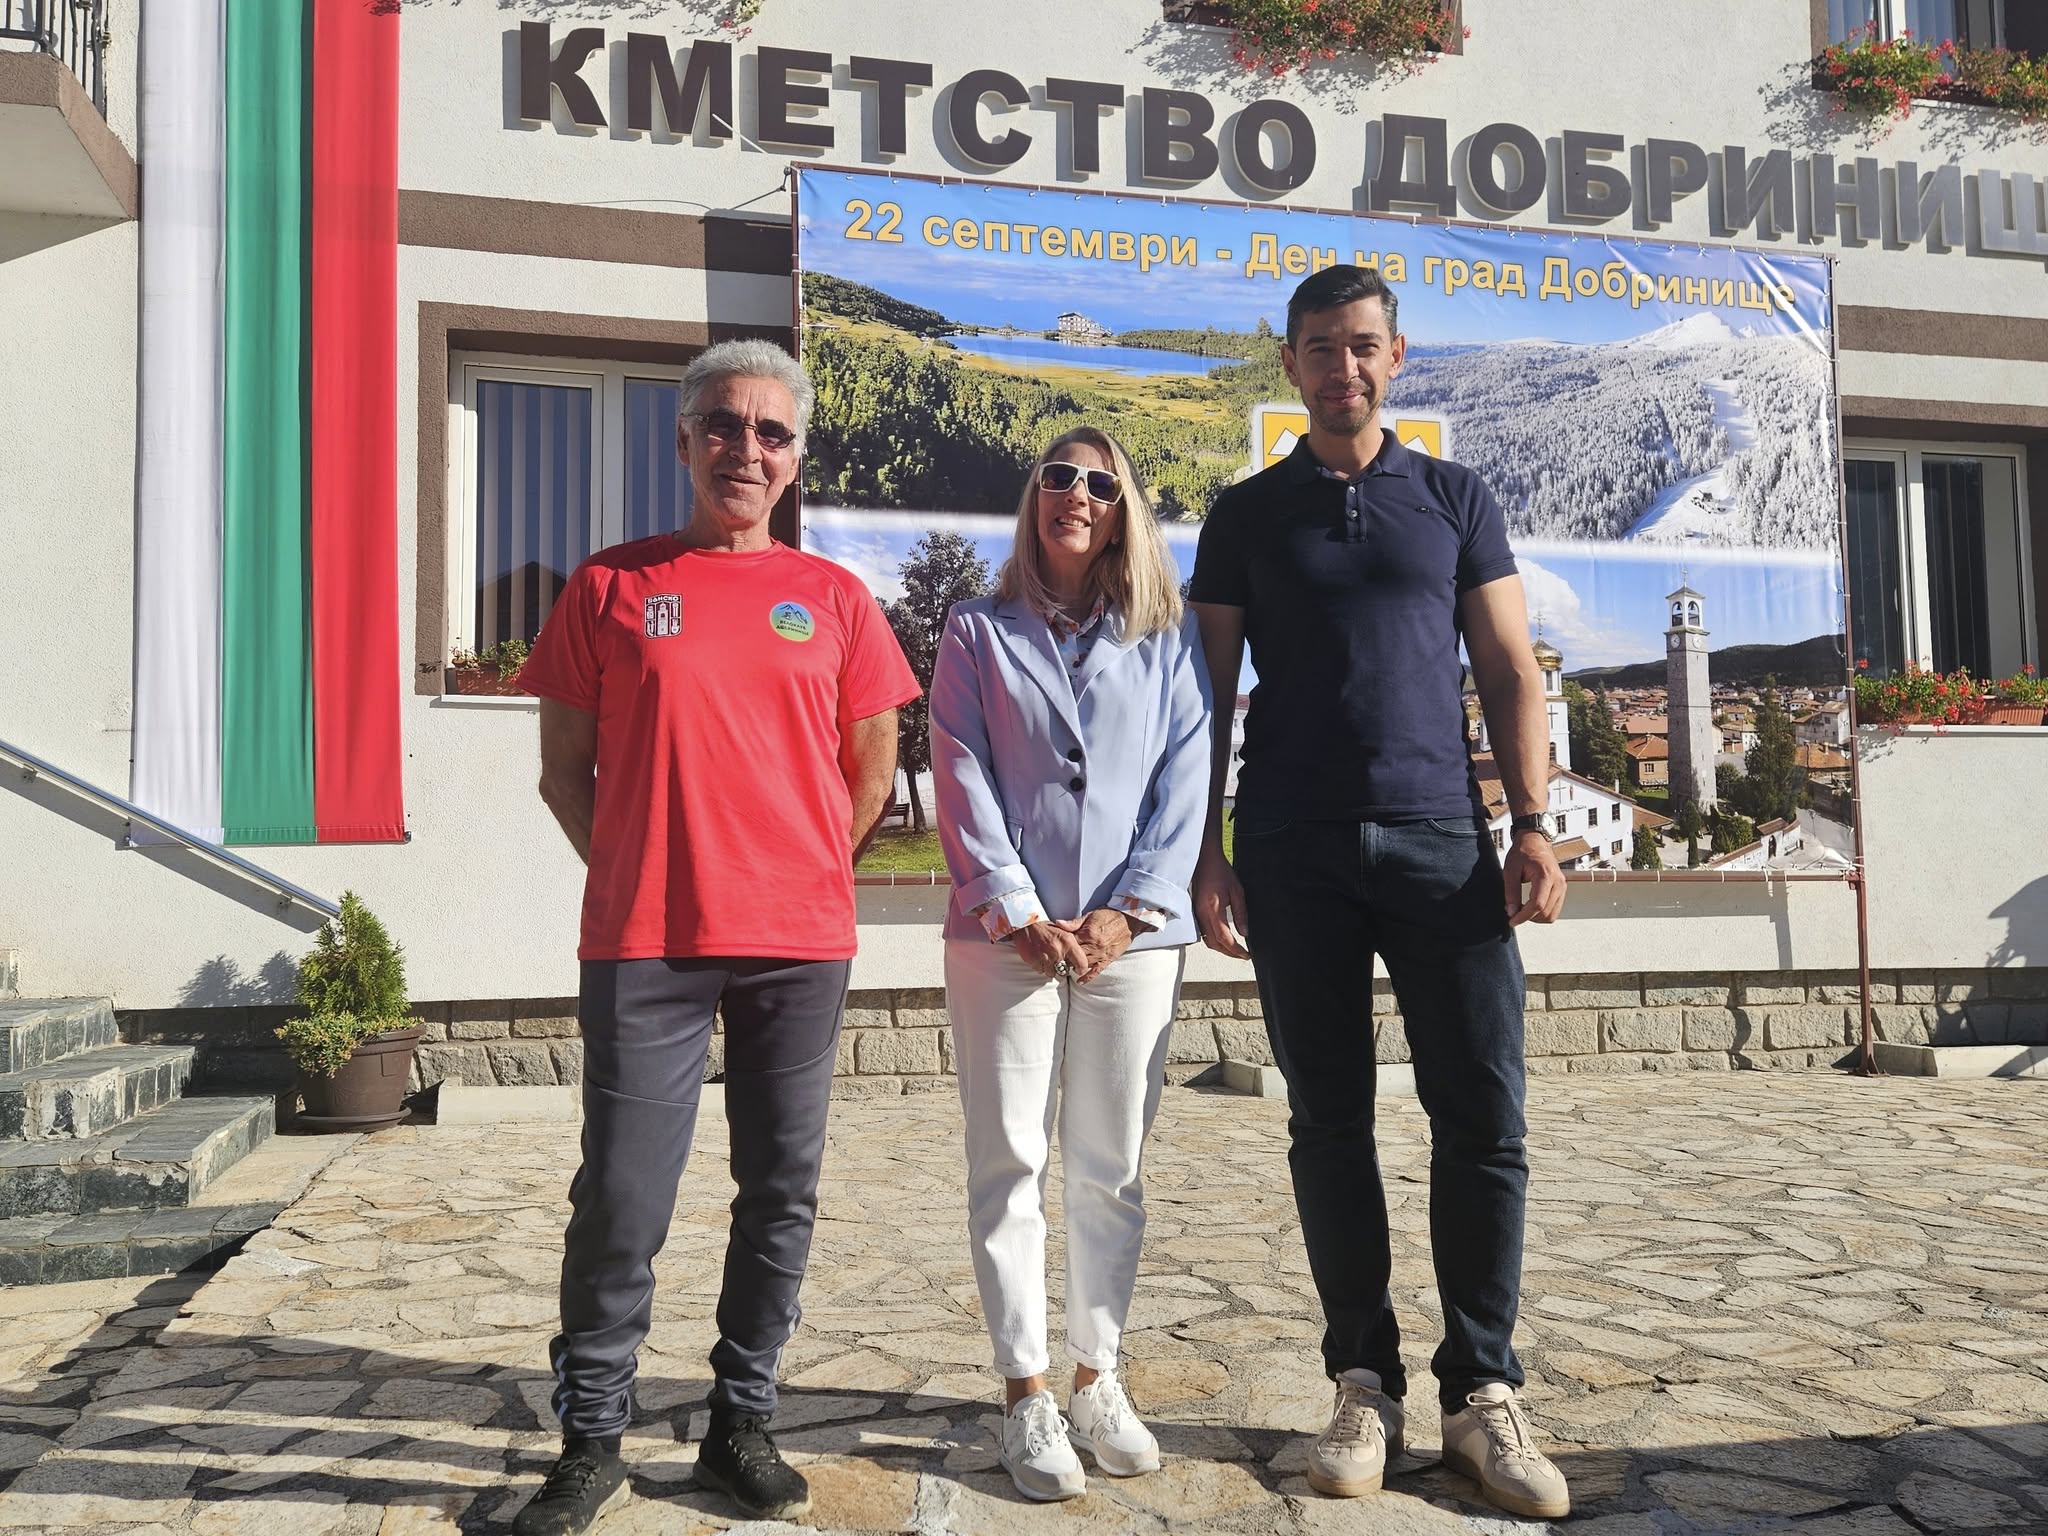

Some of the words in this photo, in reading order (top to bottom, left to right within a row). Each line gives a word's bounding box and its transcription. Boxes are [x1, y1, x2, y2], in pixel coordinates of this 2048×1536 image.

[519, 20, 1317, 194] КМЕТСТВО
[844, 199, 905, 244] 22
[922, 213, 1199, 273] септември
[1215, 249, 1233, 260] -
[1245, 232, 1337, 281] Ден
[1355, 250, 1408, 283] на
[1424, 255, 1526, 299] град
[1538, 255, 1796, 317] Добринище
